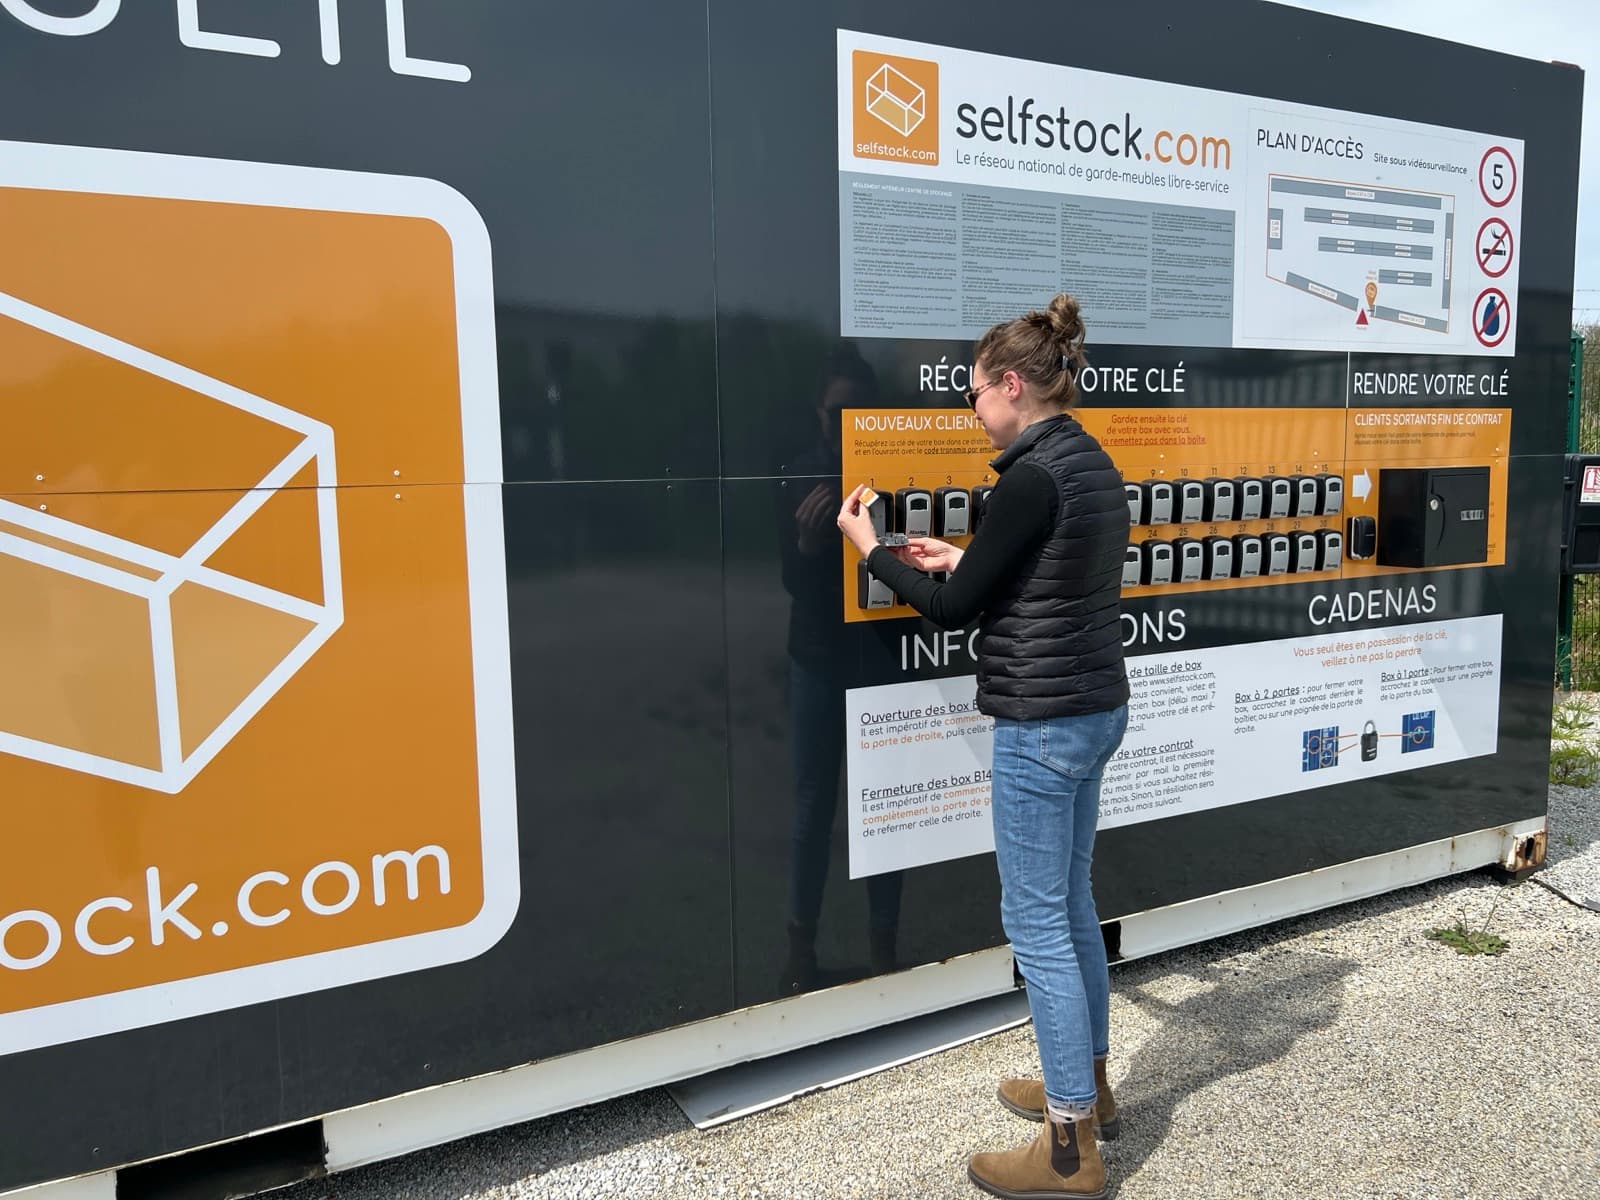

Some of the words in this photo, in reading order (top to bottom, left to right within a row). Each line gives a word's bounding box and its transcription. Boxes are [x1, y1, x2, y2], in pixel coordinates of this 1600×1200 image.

[956, 95, 1231, 170] selfstock.com
[1257, 128, 1297, 152] PLAN
[1301, 135, 1364, 160] D'ACCÈS
[856, 142, 936, 161] selfstock.com
[956, 149, 971, 165] Le
[974, 152, 1015, 170] réseau
[1018, 158, 1066, 177] national
[1069, 163, 1083, 178] de
[1085, 165, 1166, 188] garde-meubles
[1168, 174, 1229, 194] libre-service
[1373, 152, 1388, 164] Site
[1389, 156, 1407, 167] sous
[1407, 157, 1468, 175] vidéosurveillance
[1492, 163, 1504, 190] 5
[920, 356, 975, 392] RÉC
[1144, 360, 1186, 393] CLÉ
[1353, 372, 1419, 395] RENDRE
[1423, 374, 1476, 395] VOTRE
[1479, 368, 1510, 396] CLÉ
[855, 415, 932, 431] NOUVEAUX
[1111, 414, 1138, 424] Gardez
[1354, 413, 1391, 426] CLIENTS
[1392, 413, 1437, 426] SORTANTS
[1437, 413, 1451, 425] FIN
[1453, 413, 1465, 425] DE
[1465, 413, 1503, 425] CONTRAT
[908, 477, 915, 487] 2
[946, 475, 953, 485] 3
[1180, 468, 1188, 477] 10
[1212, 467, 1218, 475] 11
[1240, 466, 1248, 474] 12
[1268, 465, 1276, 474] 13
[1295, 464, 1302, 473] 14
[1321, 464, 1328, 472] 15
[1148, 529, 1158, 538] 24
[1178, 528, 1188, 537] 25
[1208, 526, 1218, 534] 26
[1308, 584, 1437, 626] CADENAS
[1293, 645, 1315, 657] Vous
[1316, 644, 1334, 655] seul
[1336, 641, 1354, 652] êtes
[1355, 640, 1366, 650] en
[1367, 635, 1412, 648] possession
[1413, 632, 1425, 642] de
[1434, 628, 1448, 640] clé,
[1321, 656, 1347, 667] veillez
[1356, 654, 1368, 663] ne
[1369, 652, 1384, 665] pas
[1394, 646, 1422, 660] perdre
[1129, 667, 1142, 678] de
[1145, 664, 1168, 676] taille
[1170, 661, 1183, 672] de
[1185, 660, 1202, 671] box
[1381, 671, 1395, 682] Box
[1408, 667, 1429, 680] porte
[1433, 665, 1446, 674] Pour
[1447, 663, 1466, 673] fermer
[1132, 680, 1148, 688] web
[1150, 687, 1184, 698] convient,
[1186, 682, 1206, 692] videz
[1235, 691, 1252, 704] Box
[1263, 688, 1270, 700] 2
[1272, 686, 1300, 700] portes
[1307, 684, 1323, 694] pour
[1324, 680, 1346, 691] fermer
[1347, 678, 1364, 688] votre
[1380, 681, 1411, 693] accrochez
[1420, 677, 1445, 687] cadenas
[1447, 675, 1456, 683] sur
[1458, 672, 1469, 681] une
[1470, 669, 1493, 680] poignée
[1151, 699, 1166, 709] box
[1168, 696, 1188, 708] (délai
[1191, 693, 1209, 703] maxi
[1234, 703, 1249, 714] box,
[1252, 699, 1287, 711] accrochez
[1299, 693, 1326, 704] cadenas
[1329, 689, 1355, 700] derrière
[1396, 689, 1412, 701] porte
[860, 708, 922, 726] Ouverture
[925, 704, 946, 718] des
[948, 702, 969, 714] box
[1136, 711, 1156, 721] nous
[1157, 708, 1177, 718] votre
[1178, 705, 1189, 715] clé
[1268, 711, 1279, 720] sur
[1280, 708, 1293, 718] une
[1293, 703, 1320, 717] poignée
[1336, 699, 1354, 710] porte
[869, 726, 883, 736] est
[886, 720, 928, 733] impératif
[930, 717, 942, 728] de
[872, 737, 899, 750] porte
[900, 734, 912, 744] de
[914, 730, 944, 743] droite,
[946, 727, 965, 741] puis
[966, 724, 987, 735] celle
[1234, 724, 1256, 735] droite.
[1108, 762, 1129, 773] votre
[1130, 758, 1159, 770] contrat,
[1165, 754, 1176, 764] est
[1177, 748, 1215, 761] nécessaire
[1117, 749, 1130, 760] de
[1132, 745, 1157, 758] votre
[1159, 739, 1194, 752] contrat
[1135, 769, 1149, 780] par
[1153, 766, 1169, 775] mail
[1183, 758, 1215, 771] première
[861, 784, 924, 801] Fermeture
[927, 779, 948, 791] des
[950, 775, 971, 787] box
[974, 770, 993, 783] B14
[1102, 786, 1113, 796] du
[1115, 783, 1133, 793] mois
[1143, 778, 1161, 788] vous
[1162, 772, 1198, 785] souhaitez
[1131, 791, 1154, 802] Sinon,
[1163, 781, 1198, 795] résiliation
[1199, 779, 1215, 789] sera
[862, 806, 928, 825] complètement
[931, 804, 940, 814] la
[942, 800, 968, 813] porte
[970, 797, 981, 807] de
[870, 801, 884, 812] est
[886, 793, 928, 808] impératif
[930, 791, 942, 802] de
[1112, 806, 1123, 815] fin
[1124, 804, 1135, 813] du
[1135, 800, 1154, 811] mois
[1154, 796, 1183, 807] suivant.
[862, 827, 875, 838] de
[877, 821, 917, 836] refermer
[919, 817, 940, 829] celle
[941, 813, 953, 823] de
[955, 809, 984, 822] droite.
[0, 844, 451, 970] ock.com
